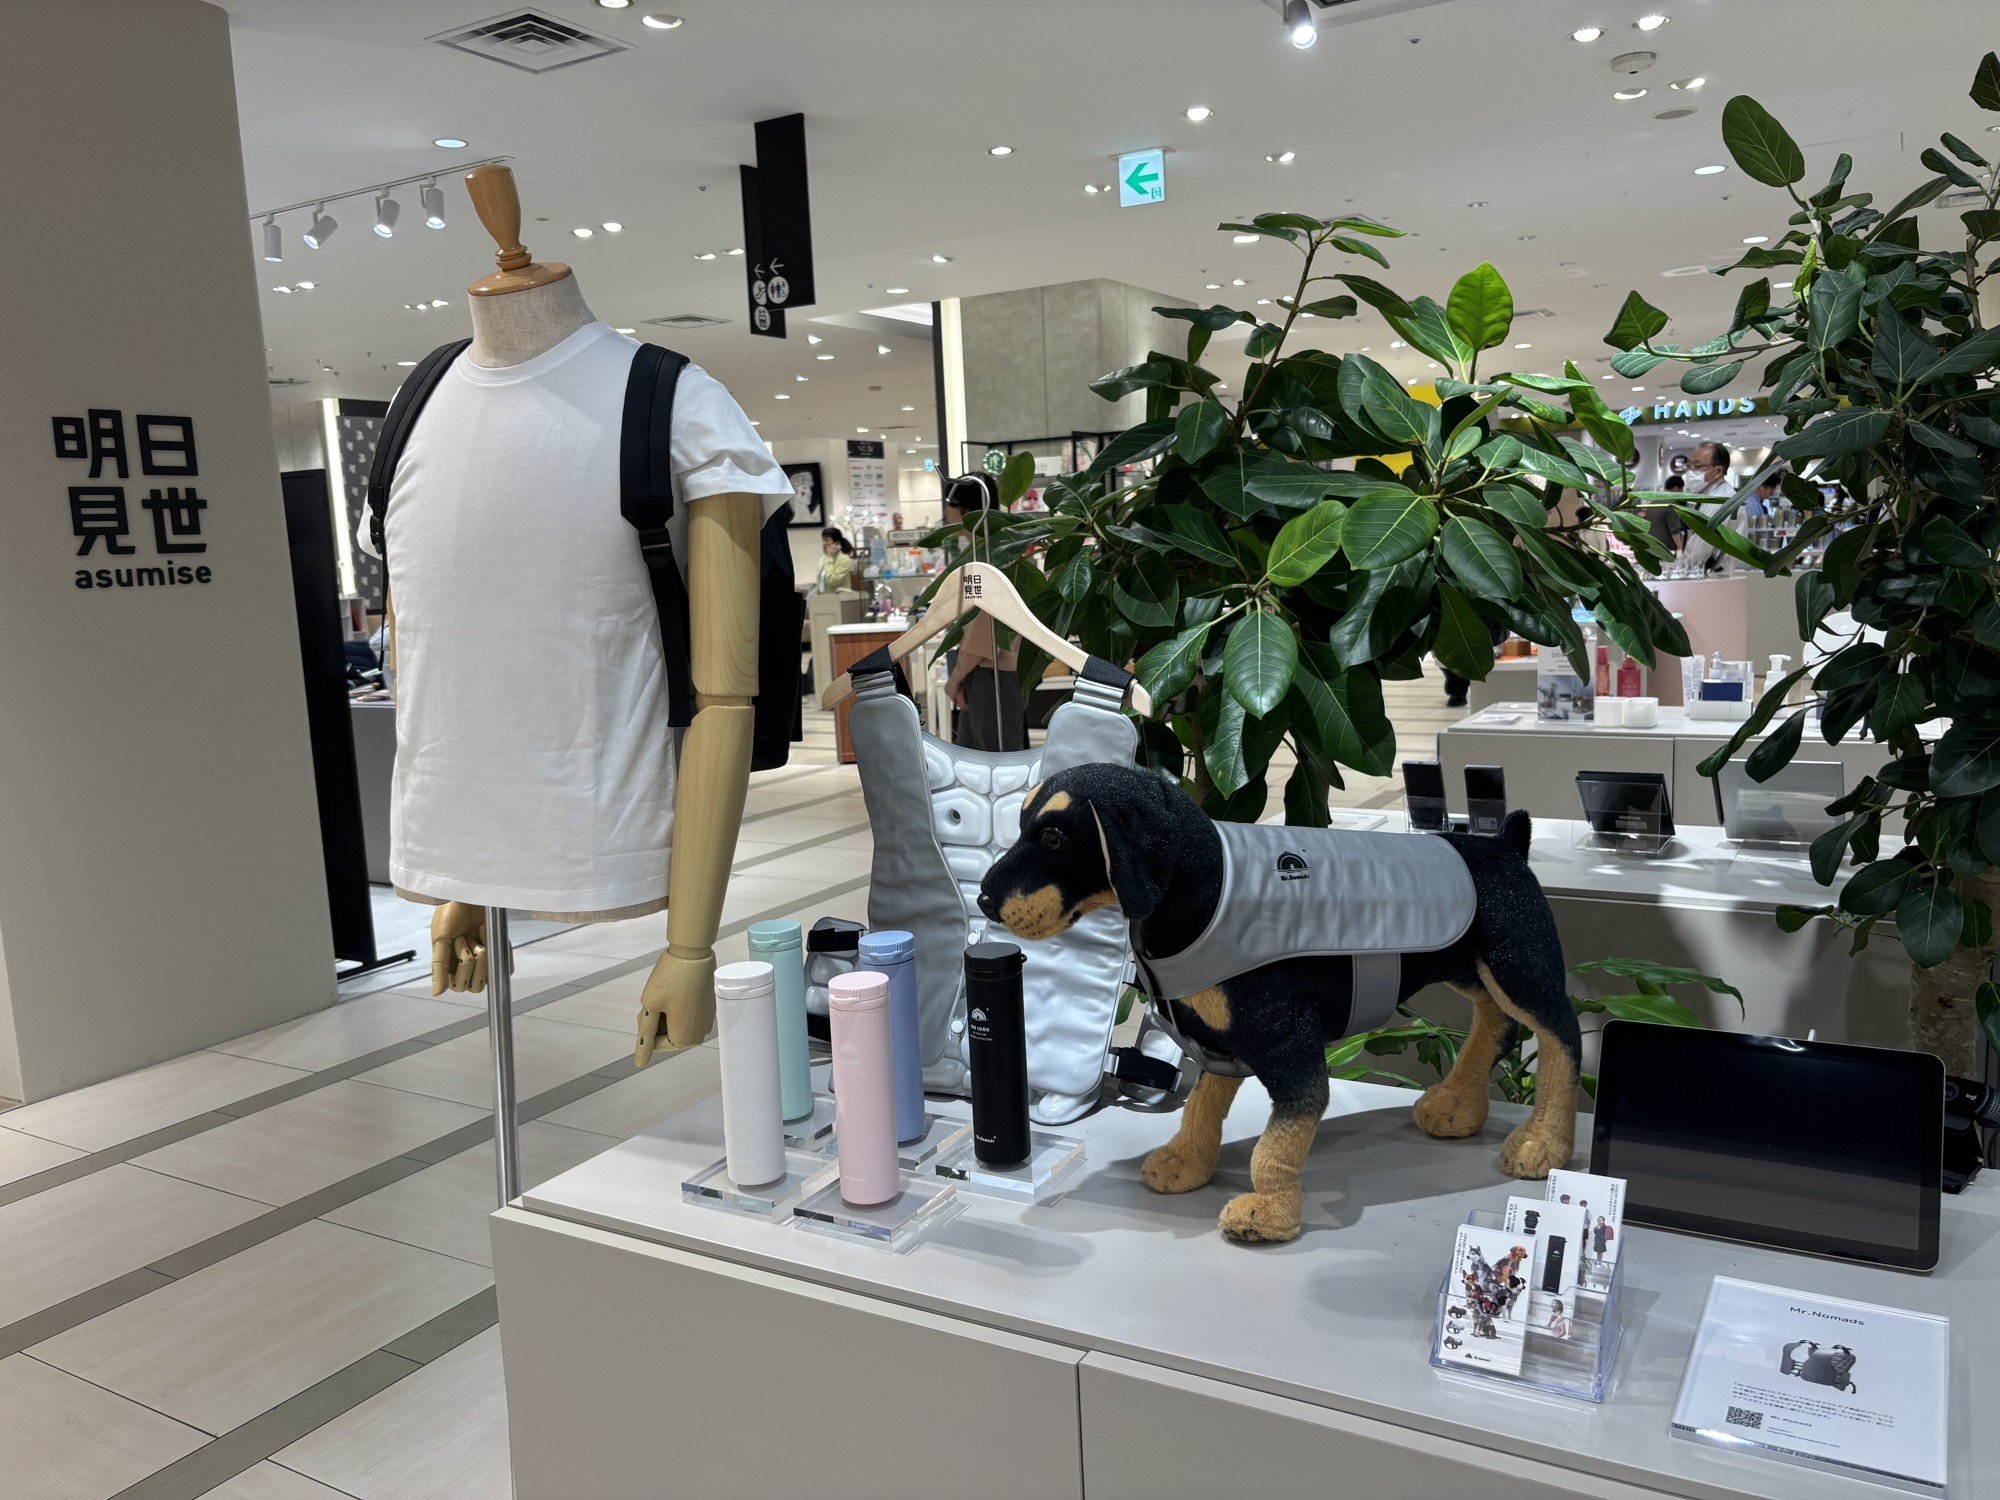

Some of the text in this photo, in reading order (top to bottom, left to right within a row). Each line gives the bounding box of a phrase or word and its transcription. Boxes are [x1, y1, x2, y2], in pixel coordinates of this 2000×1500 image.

[1654, 397, 1756, 419] HANDS
[52, 409, 198, 478] 明日
[68, 487, 207, 555] 見世
[75, 561, 212, 589] asumise
[963, 575, 982, 584] 明日
[965, 585, 982, 595] 見世
[1965, 1093, 1978, 1101] logi
[1790, 1306, 1865, 1326] Mr.Nomads
